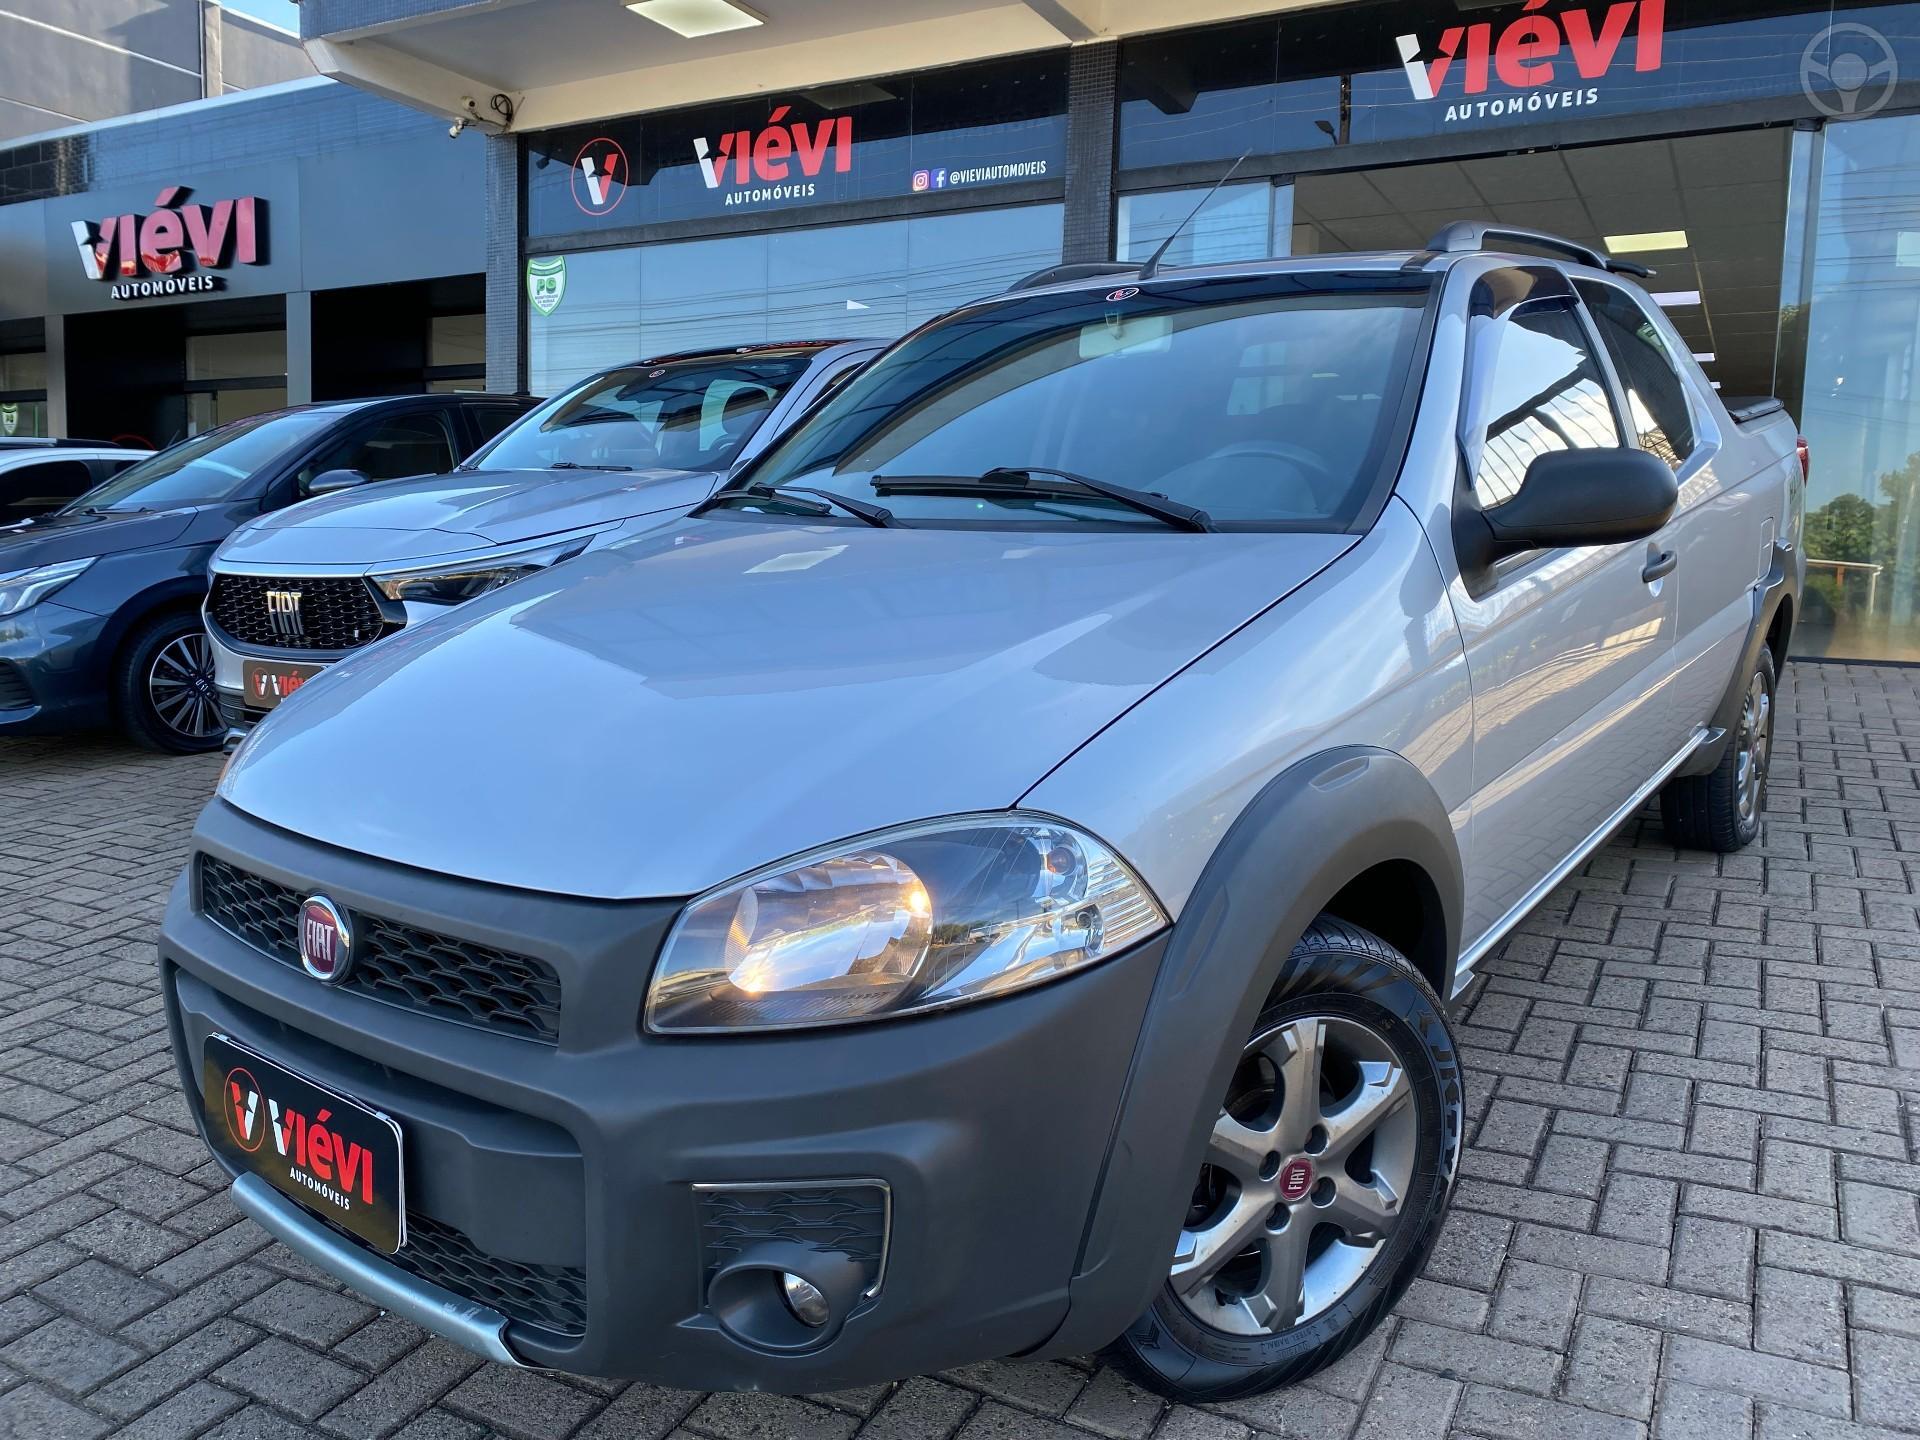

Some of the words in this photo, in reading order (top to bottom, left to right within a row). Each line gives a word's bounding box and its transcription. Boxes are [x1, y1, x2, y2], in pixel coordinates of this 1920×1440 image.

[1444, 88, 1598, 122] AUTOMÓVEIS
[950, 160, 1047, 184] @VIEVIAUTOMOVEIS
[724, 183, 816, 206] AUTOMÓVEIS
[111, 275, 214, 299] AUTOMÓVEIS
[307, 918, 335, 961] FIAT
[290, 1166, 351, 1211] AUTOMÓVEIS
[1287, 1167, 1306, 1190] FIAT
